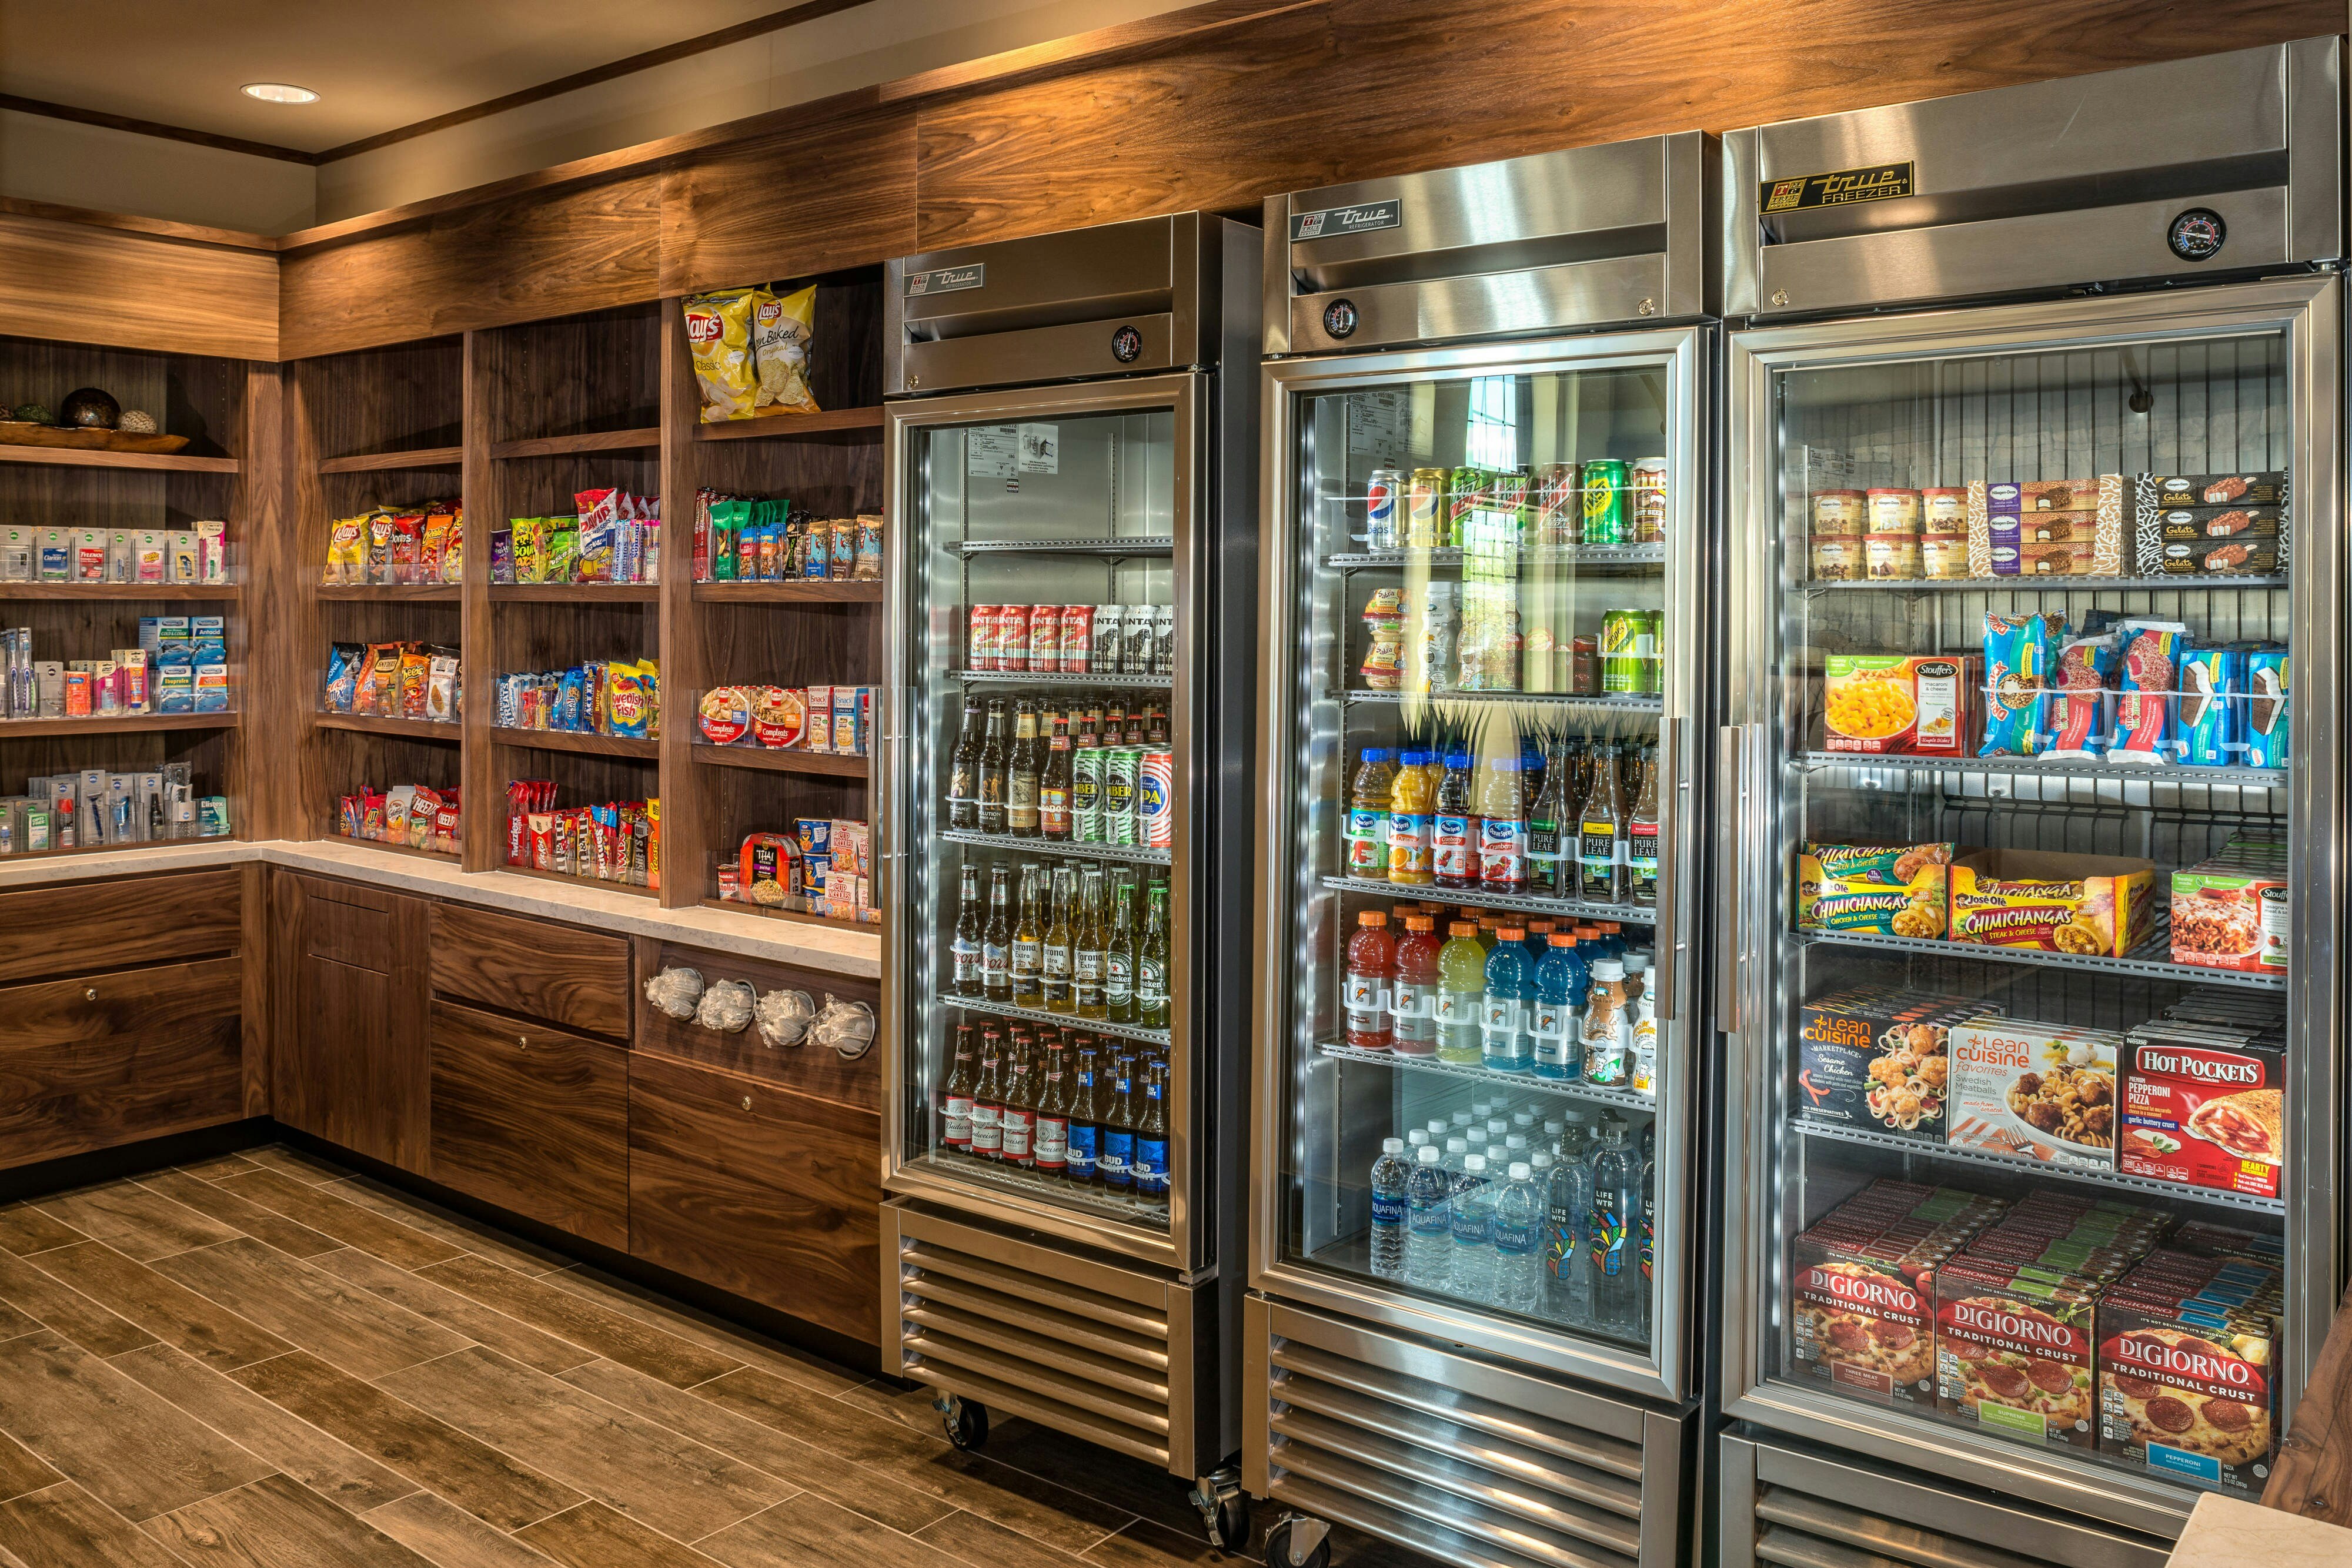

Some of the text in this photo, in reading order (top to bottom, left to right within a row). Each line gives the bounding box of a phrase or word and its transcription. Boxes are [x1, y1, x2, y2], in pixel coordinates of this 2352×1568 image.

[1812, 171, 1901, 194] true
[1822, 186, 1900, 203] FREEZER
[1334, 209, 1390, 225] true
[1349, 220, 1384, 229] REFRIGERATOR
[936, 272, 975, 285] true
[759, 300, 781, 320] Lay's
[767, 326, 799, 344] Baked
[763, 344, 788, 357] Original
[696, 360, 721, 371] Classic
[581, 505, 610, 533] DAVID
[514, 546, 536, 555] SOUR
[1920, 664, 1953, 677] Stouffer's
[612, 693, 644, 707] Swedish
[811, 695, 826, 703] Snack
[837, 696, 851, 704] Snack
[616, 704, 636, 718] Fish
[709, 724, 735, 734] Compleats
[762, 728, 789, 737] Compleats
[201, 801, 223, 809] Blistex
[838, 831, 850, 840] CUP
[1489, 828, 1514, 838] Ocean Spray
[1533, 834, 1554, 843] PURE
[834, 838, 853, 848] NOODLES
[1586, 838, 1610, 847] PURE
[597, 829, 608, 878] Skittles
[617, 834, 626, 874] TWIX
[757, 850, 774, 861] THAI
[834, 884, 847, 892] CUP
[828, 891, 851, 900] NOODLES
[1811, 896, 1908, 920] CHIMICHANGAS
[1831, 917, 1852, 925] CHICKEN
[1965, 911, 2075, 936] CHIMICHANGAS
[1989, 931, 2007, 939] STEAK
[1075, 951, 1103, 963] Corona
[1813, 1045, 1860, 1058] MARKETPLACE
[1818, 1054, 1845, 1065] Sesame
[1824, 1064, 1853, 1076] Chicken
[1953, 1062, 2008, 1076] favorites
[2143, 1051, 2258, 1083] HOT POCKETS
[1956, 1075, 1992, 1085] Swedish
[1956, 1082, 1997, 1095] Meatballs
[2129, 1082, 2170, 1097] PEPPERONI
[2129, 1094, 2149, 1105] PIZZA
[1810, 1106, 1844, 1116] PRESERVATIVES
[2143, 1118, 2160, 1127] buttery
[1068, 1149, 1083, 1159] BUD
[1104, 1155, 1122, 1165] BUD
[2241, 1160, 2270, 1172] HEARTY
[1596, 1190, 1613, 1199] LIFE
[1596, 1199, 1613, 1208] WTR
[1412, 1213, 1446, 1225] AQUAFINA
[1551, 1214, 1566, 1222] WTR
[1453, 1220, 1485, 1234] AQUAFINA
[1804, 1292, 1921, 1325] TRADITIONAL CRUST
[1947, 1327, 2077, 1362] TRADITIONAL CRUST
[1845, 1368, 1877, 1380] THREE MEAT
[2112, 1363, 2255, 1402] TRADITIONAL CRUST
[1997, 1410, 2026, 1420] SUPREME
[2166, 1454, 2201, 1467] PEPPERONI
